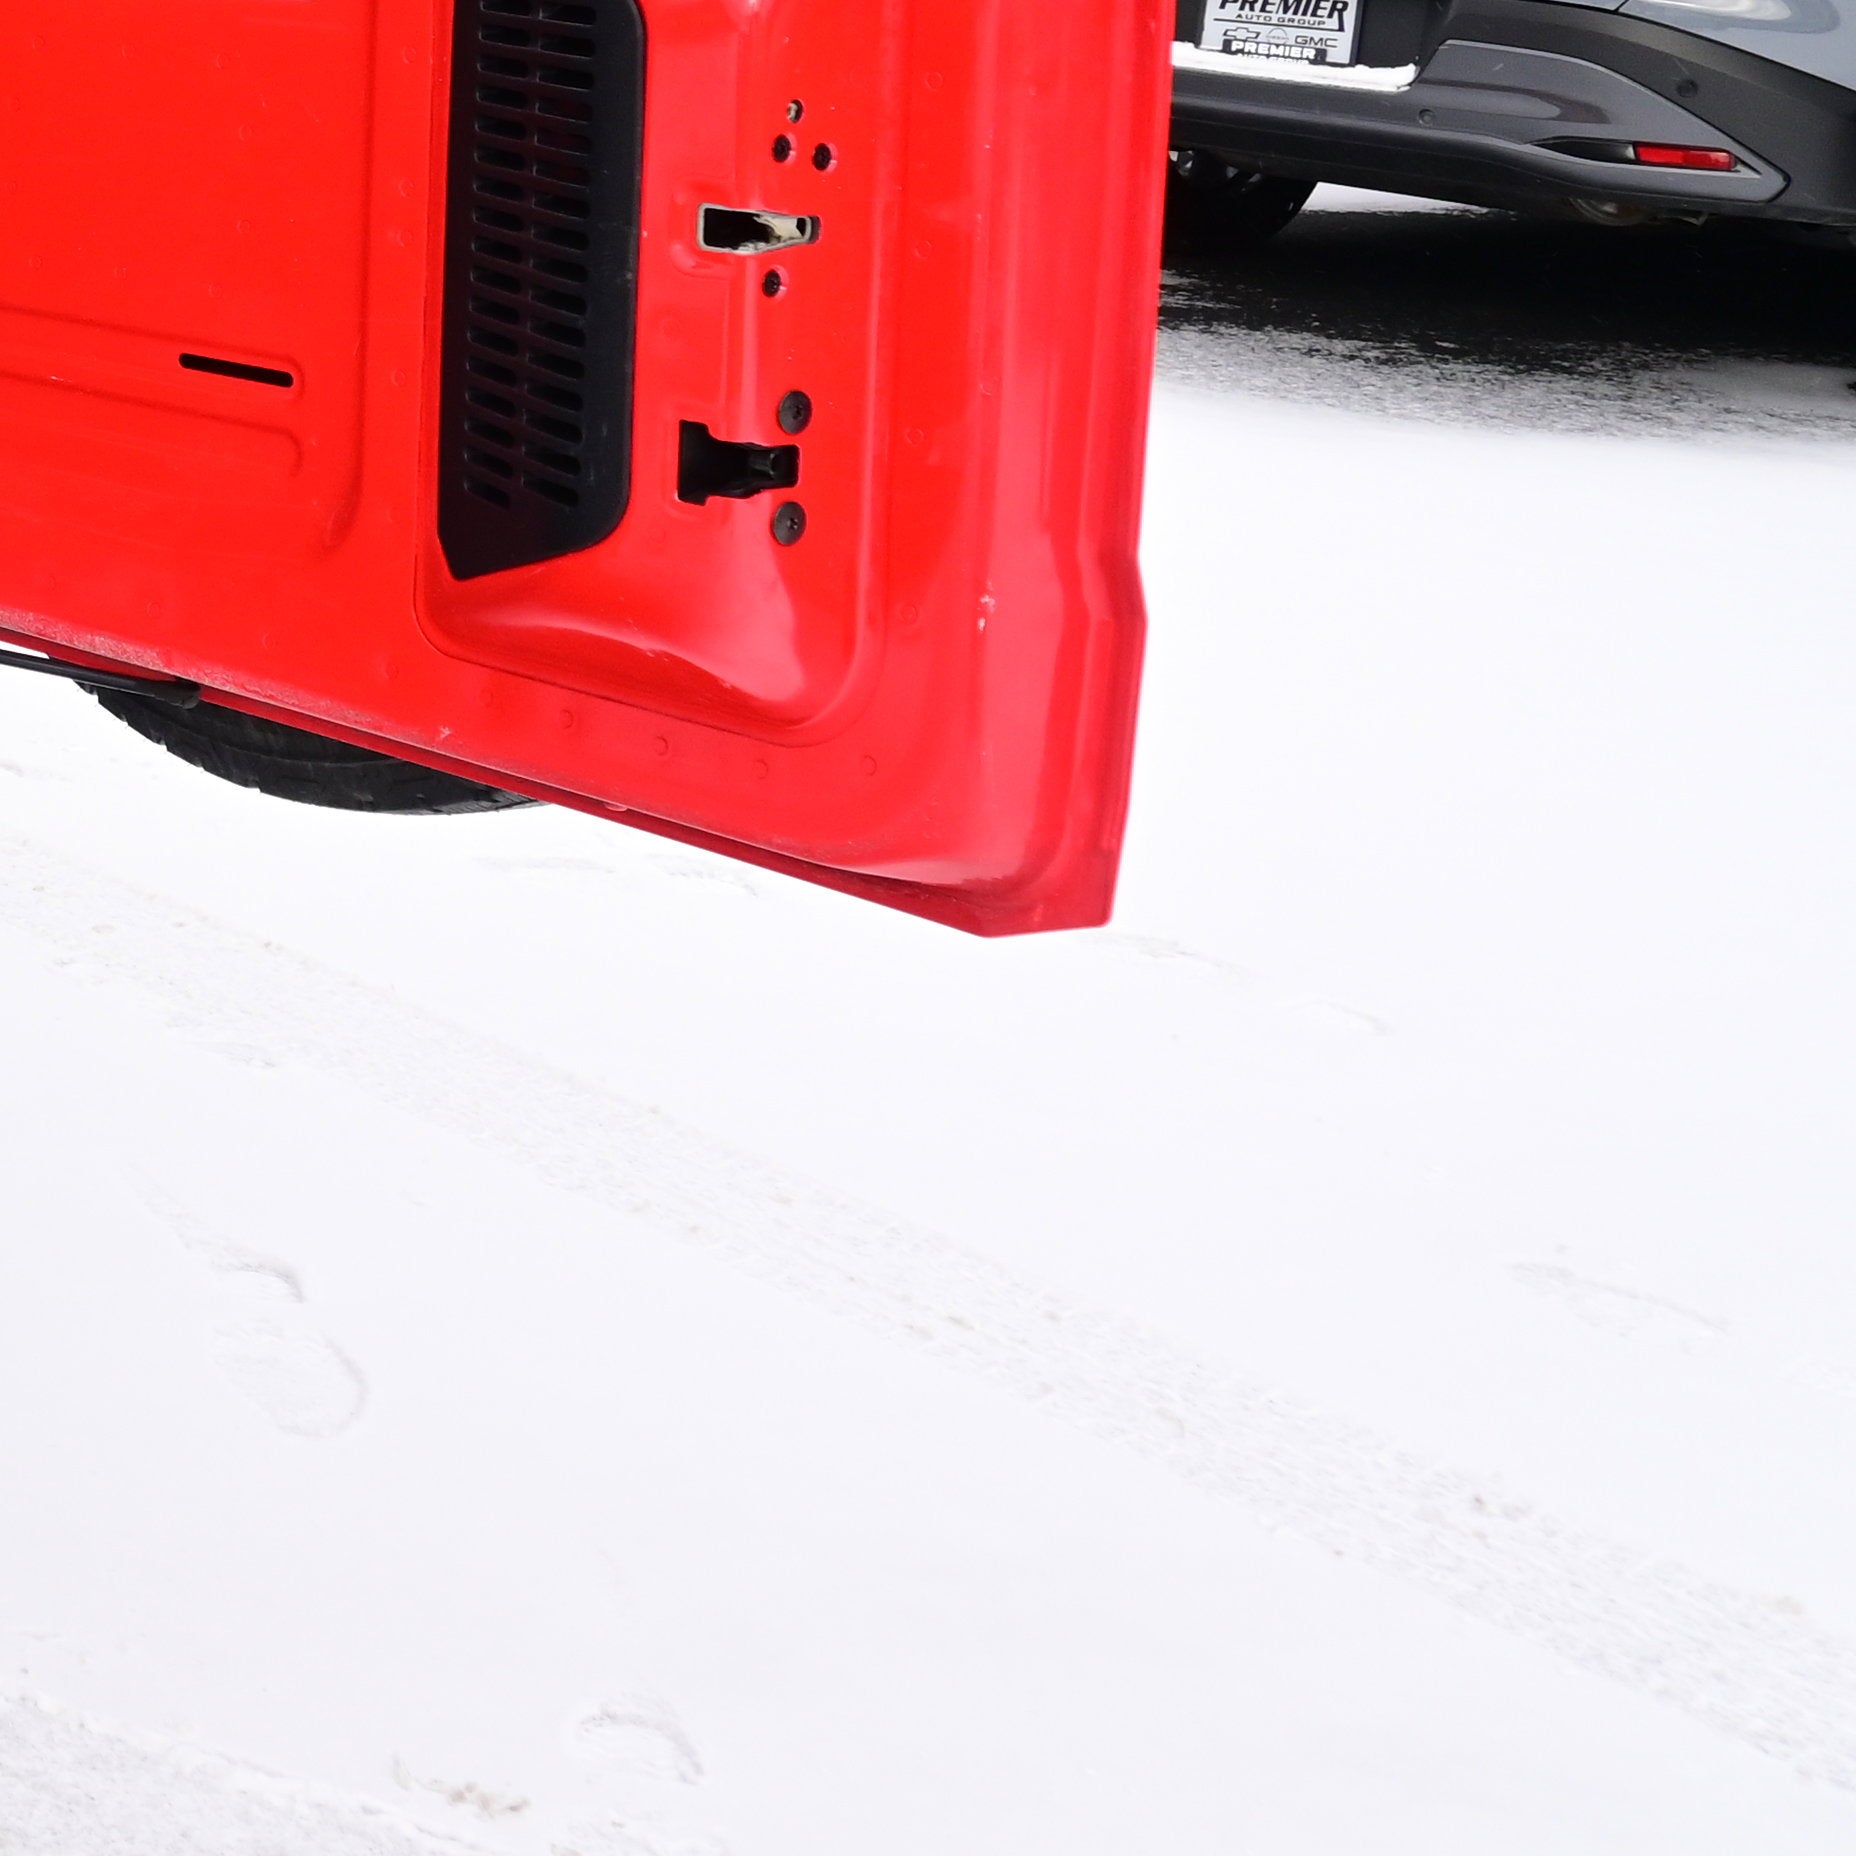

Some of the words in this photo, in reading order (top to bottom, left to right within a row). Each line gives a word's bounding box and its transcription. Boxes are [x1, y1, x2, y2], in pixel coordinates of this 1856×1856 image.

[1235, 13, 1273, 23] AUTO
[1277, 16, 1326, 27] GROUP
[1295, 35, 1338, 48] GMC
[1231, 40, 1316, 60] PREMIER
